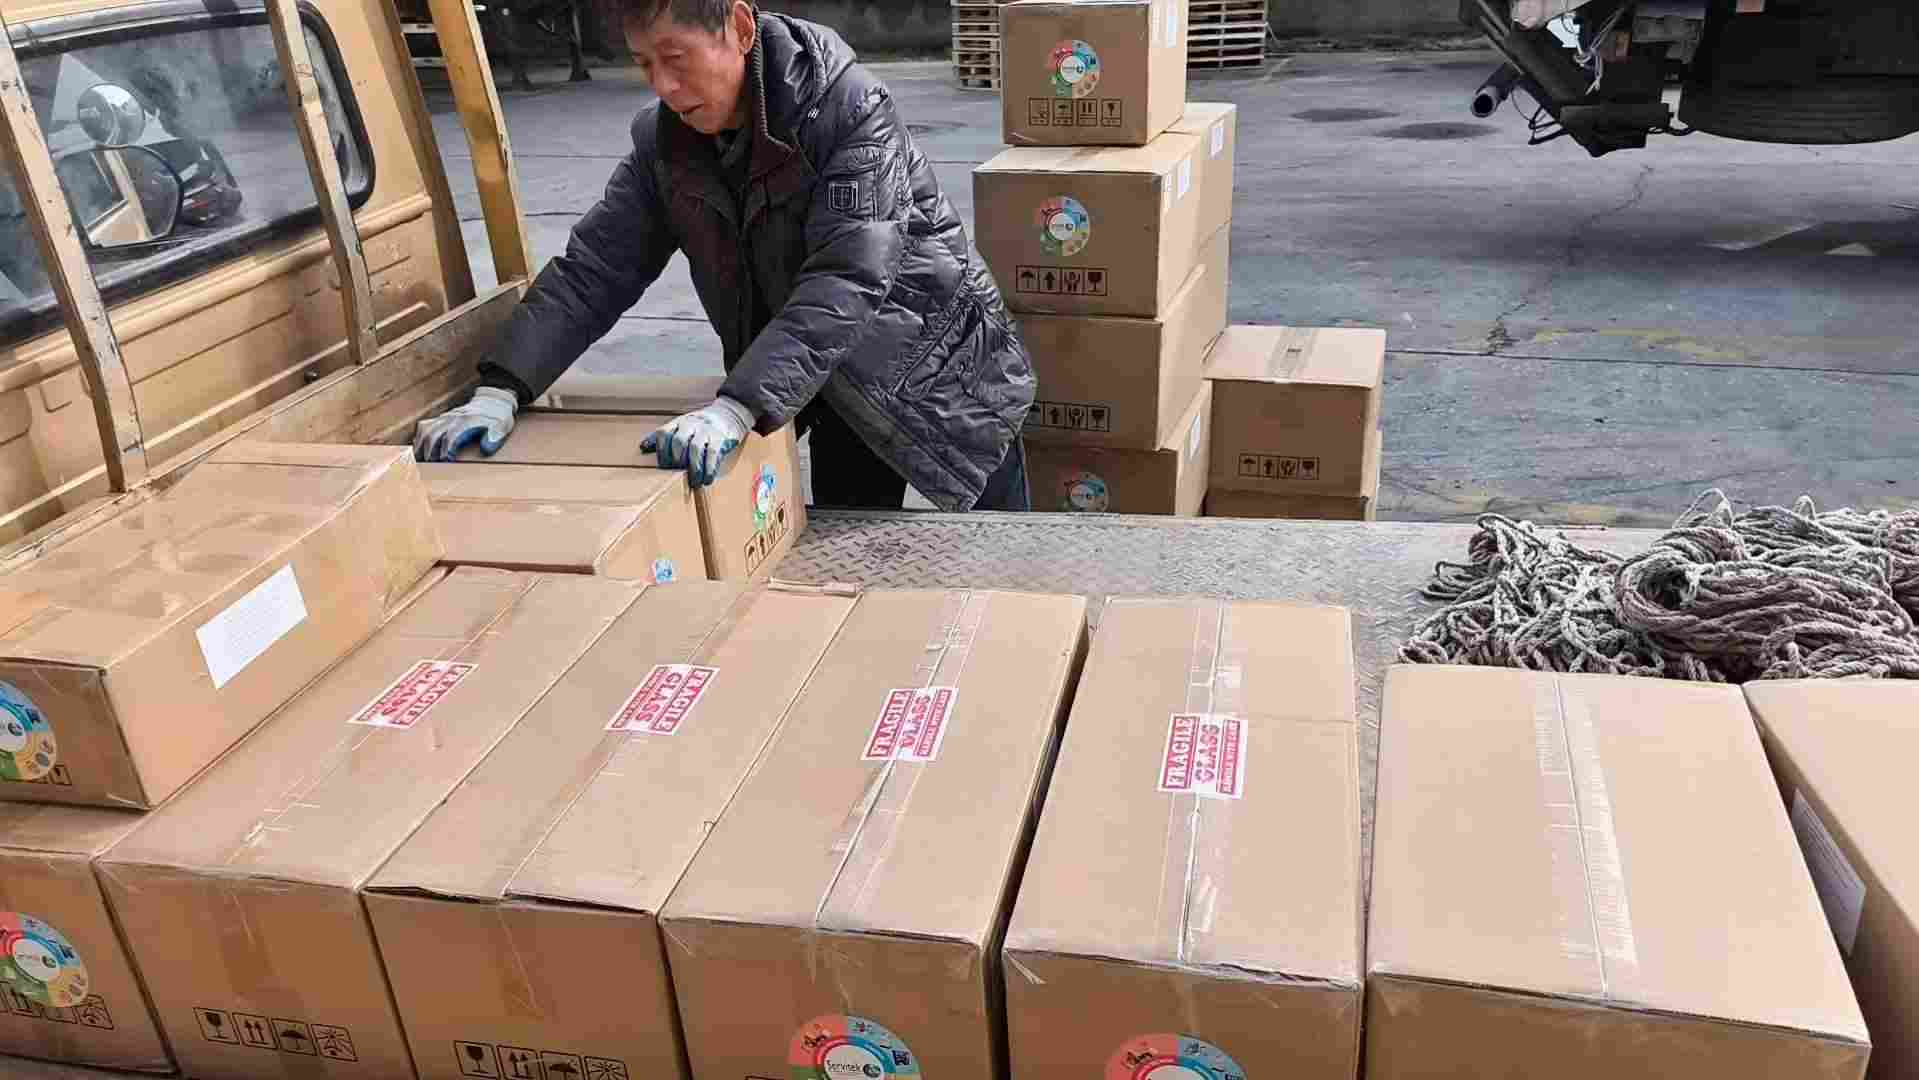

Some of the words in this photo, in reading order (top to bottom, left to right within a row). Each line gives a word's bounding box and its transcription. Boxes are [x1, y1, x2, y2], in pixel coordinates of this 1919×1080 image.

[635, 672, 684, 721] GLASS
[655, 671, 706, 731] FRAGILE
[870, 692, 908, 754] FRAGILE
[898, 695, 931, 746] GLASS
[1168, 717, 1193, 786] FRAGILE
[1195, 724, 1218, 781] GLASS
